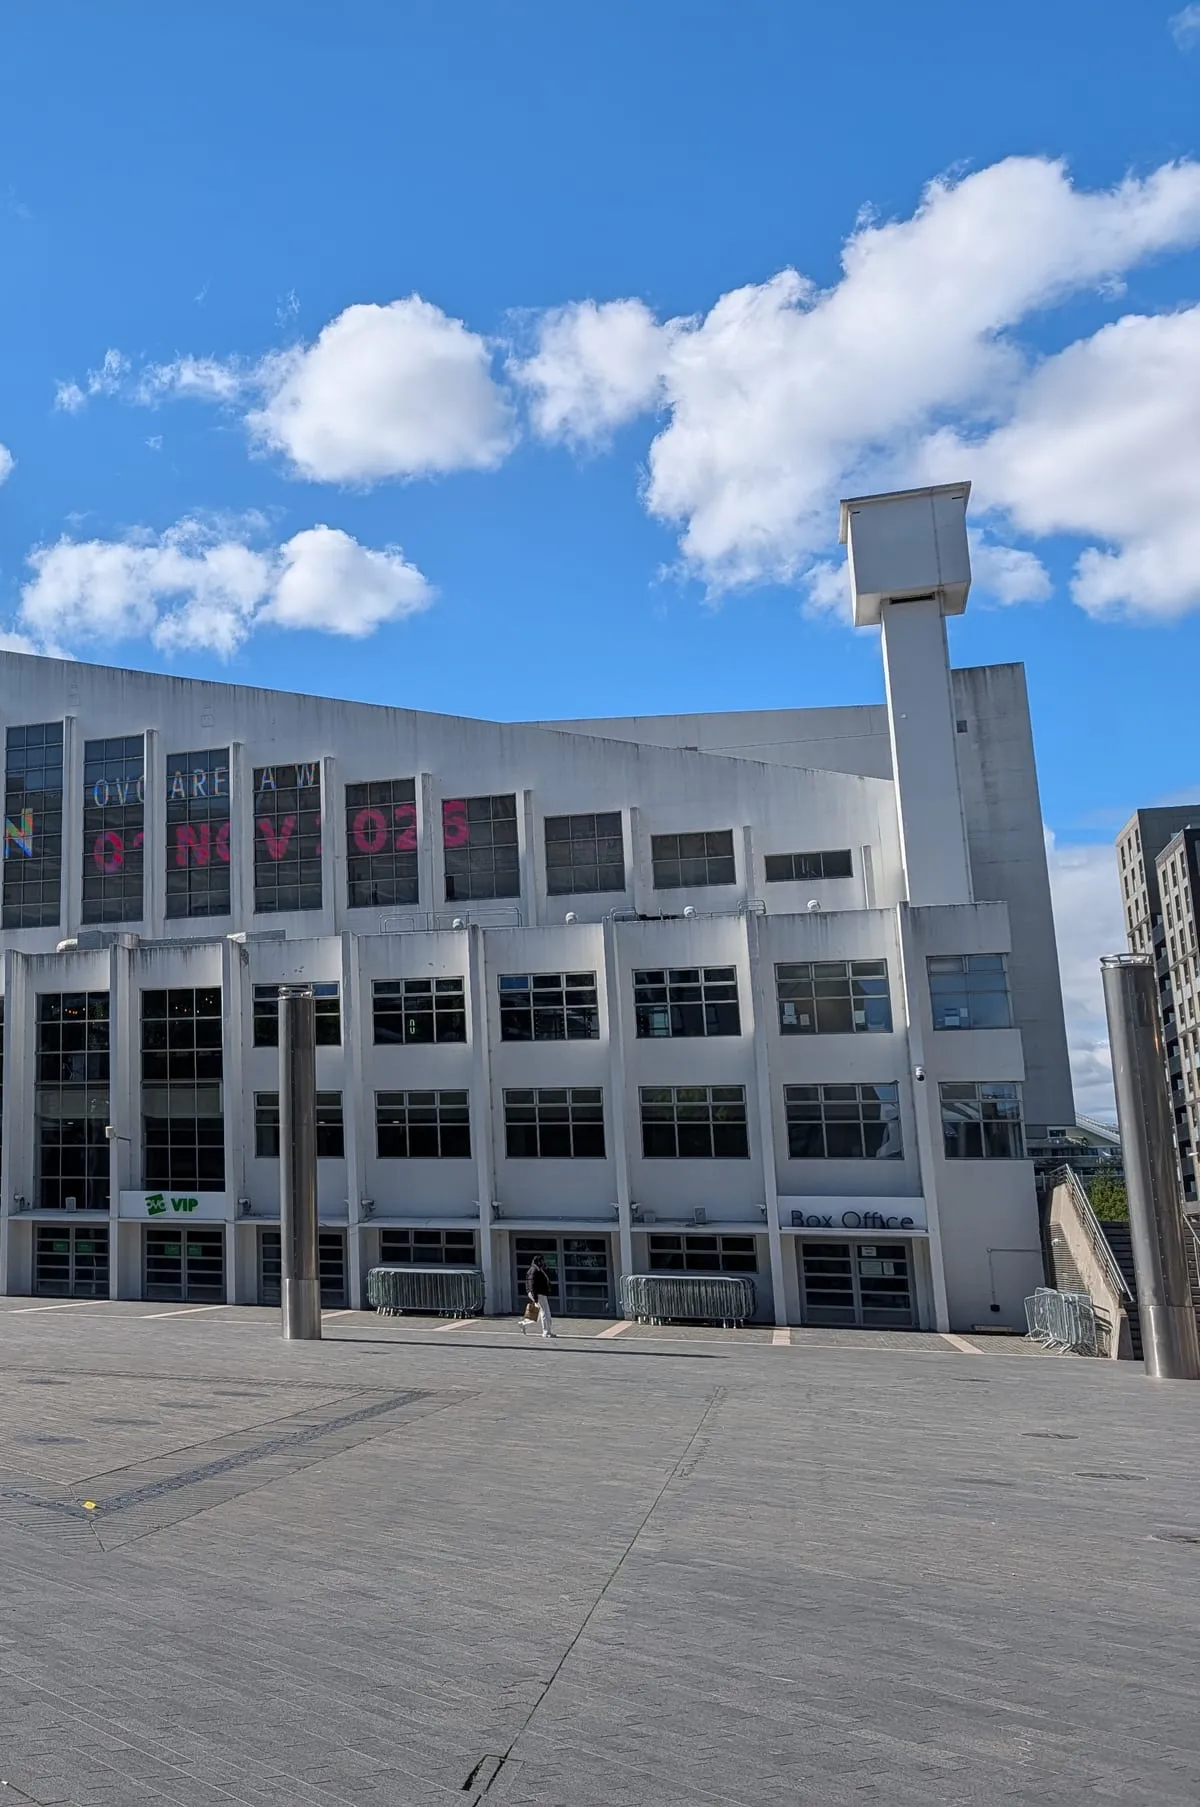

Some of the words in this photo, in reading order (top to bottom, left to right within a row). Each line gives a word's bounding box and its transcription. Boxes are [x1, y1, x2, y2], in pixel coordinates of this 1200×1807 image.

[170, 1198, 199, 1212] VIP
[791, 1210, 833, 1228] Box
[842, 1211, 914, 1230] Office
